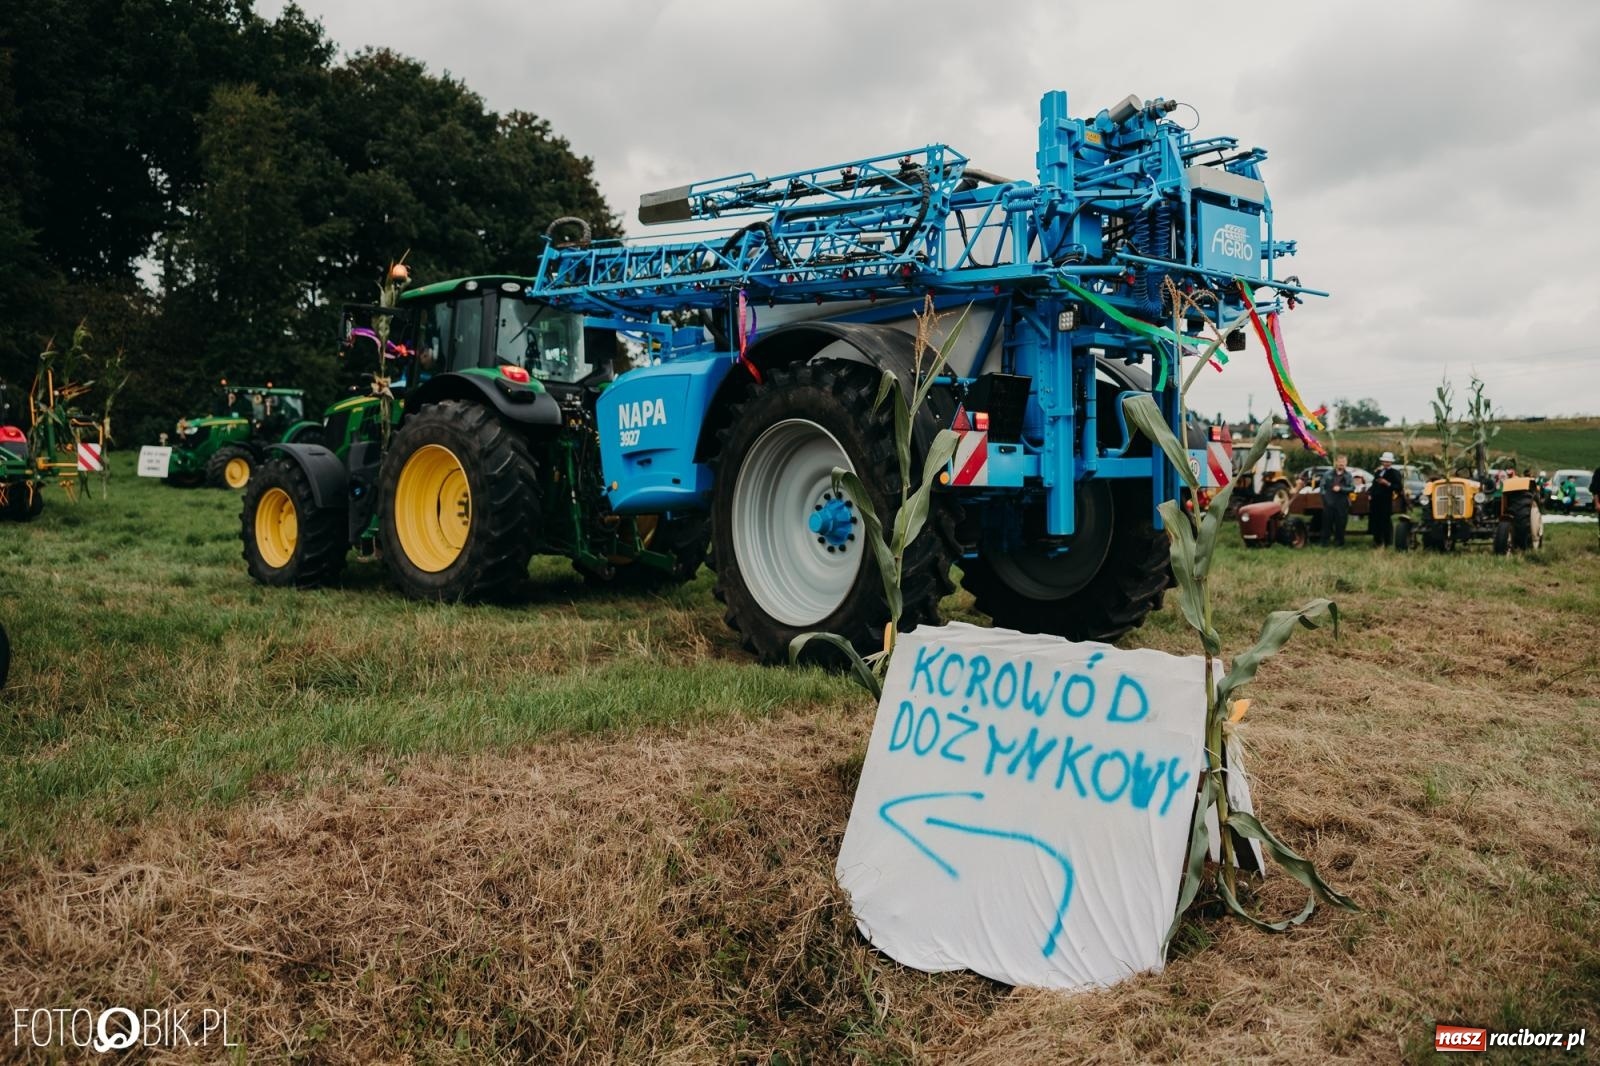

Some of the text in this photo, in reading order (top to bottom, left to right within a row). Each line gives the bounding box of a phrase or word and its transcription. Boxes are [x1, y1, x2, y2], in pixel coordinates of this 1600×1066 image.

[1211, 227, 1253, 261] AGRIO
[618, 398, 667, 430] NAPA
[619, 429, 641, 447] 3927
[909, 644, 1151, 725] KOROWÓD
[887, 698, 1191, 817] DOŻYNKOWY
